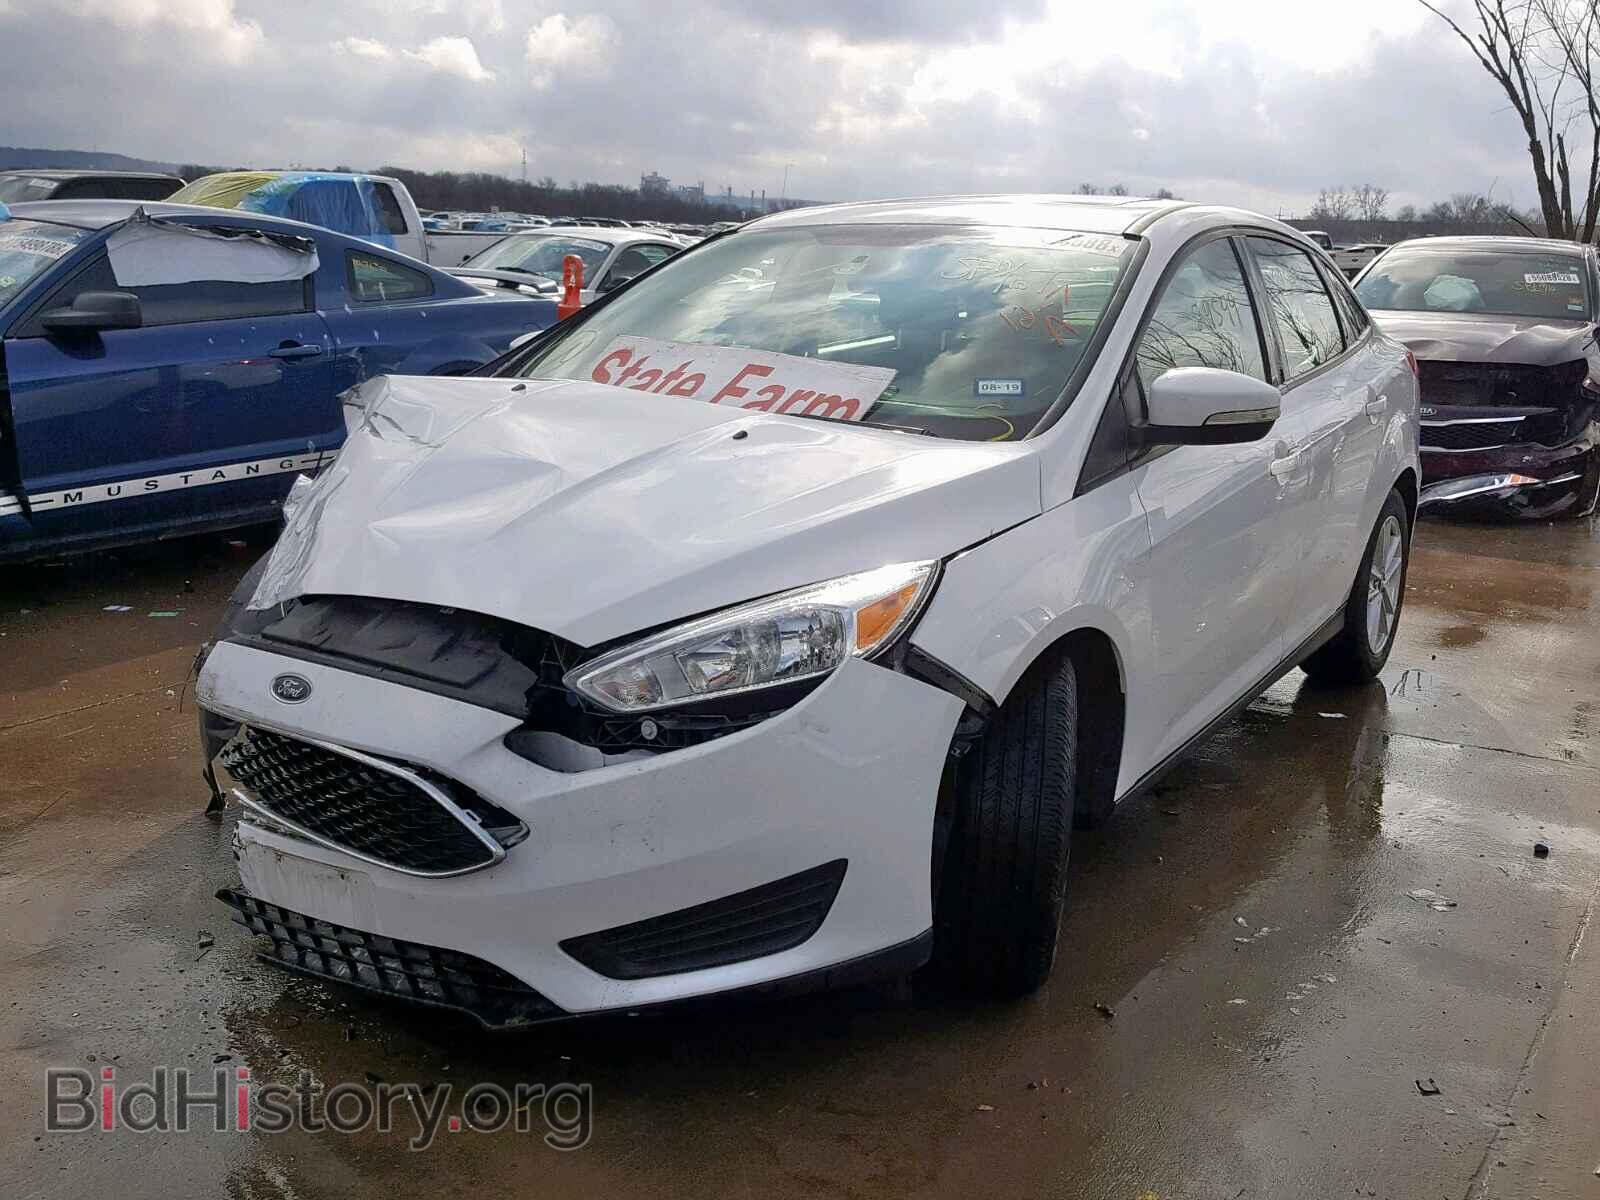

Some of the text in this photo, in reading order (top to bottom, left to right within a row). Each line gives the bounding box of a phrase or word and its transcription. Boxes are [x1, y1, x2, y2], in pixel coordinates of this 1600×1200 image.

[591, 348, 860, 420] State Farm
[981, 383, 1019, 391] 08-19
[63, 459, 293, 503] MUSTANG
